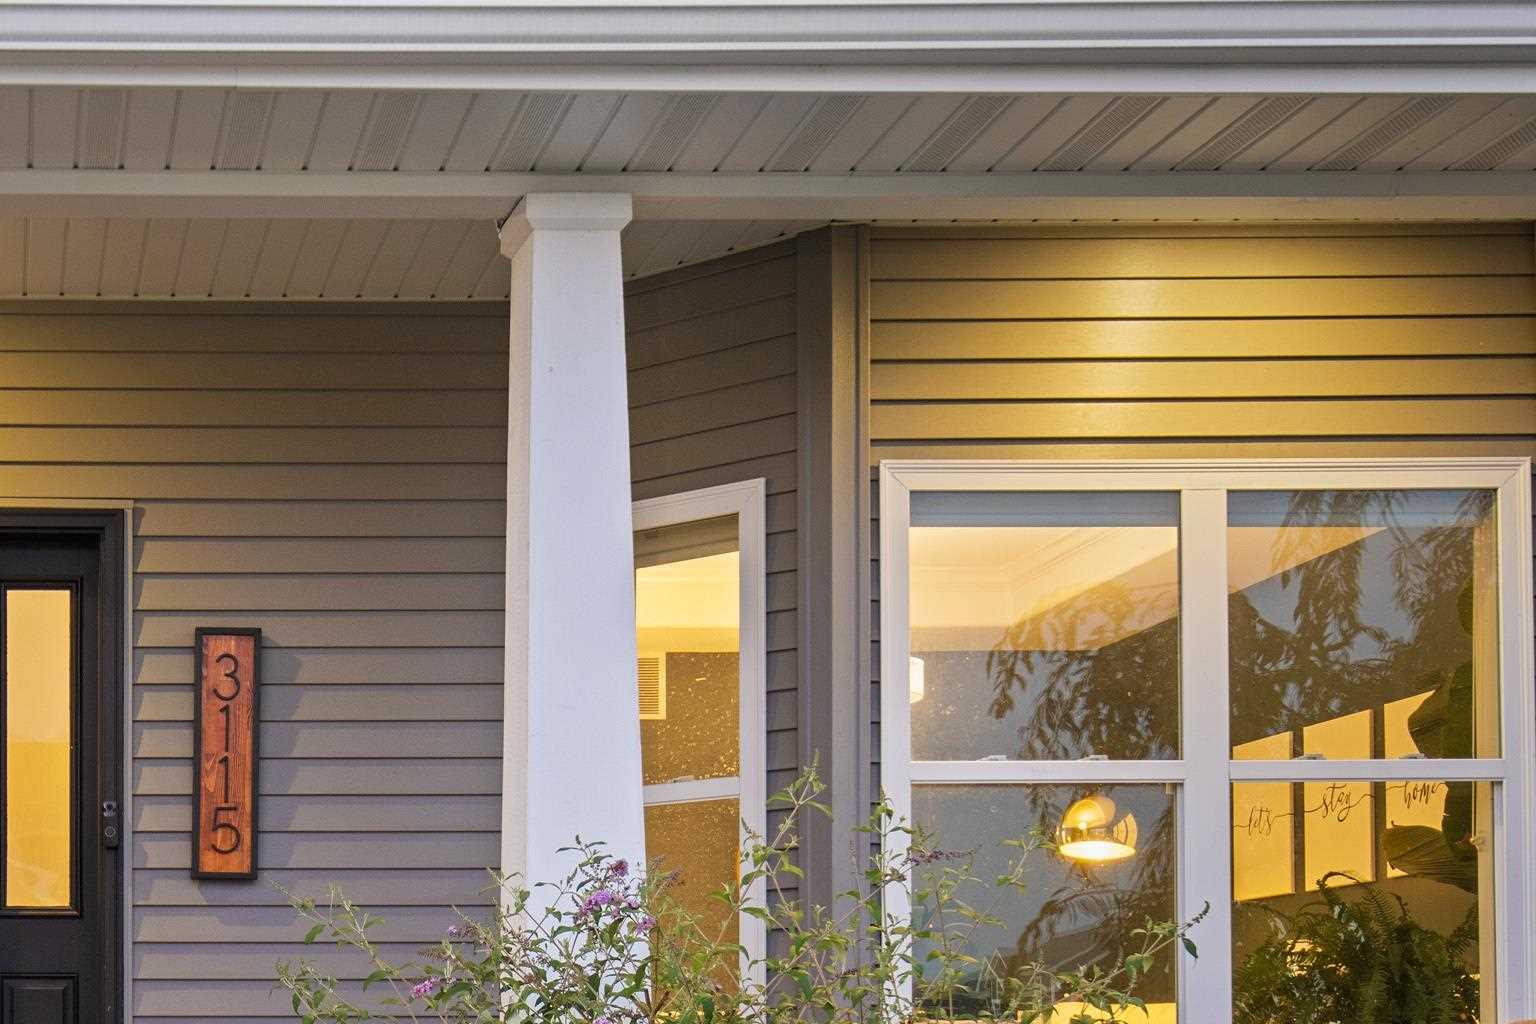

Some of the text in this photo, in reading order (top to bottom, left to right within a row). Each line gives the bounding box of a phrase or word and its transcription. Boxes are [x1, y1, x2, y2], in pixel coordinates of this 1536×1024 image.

[212, 653, 241, 855] 3115
[1318, 783, 1356, 822] stay
[1401, 780, 1441, 809] home
